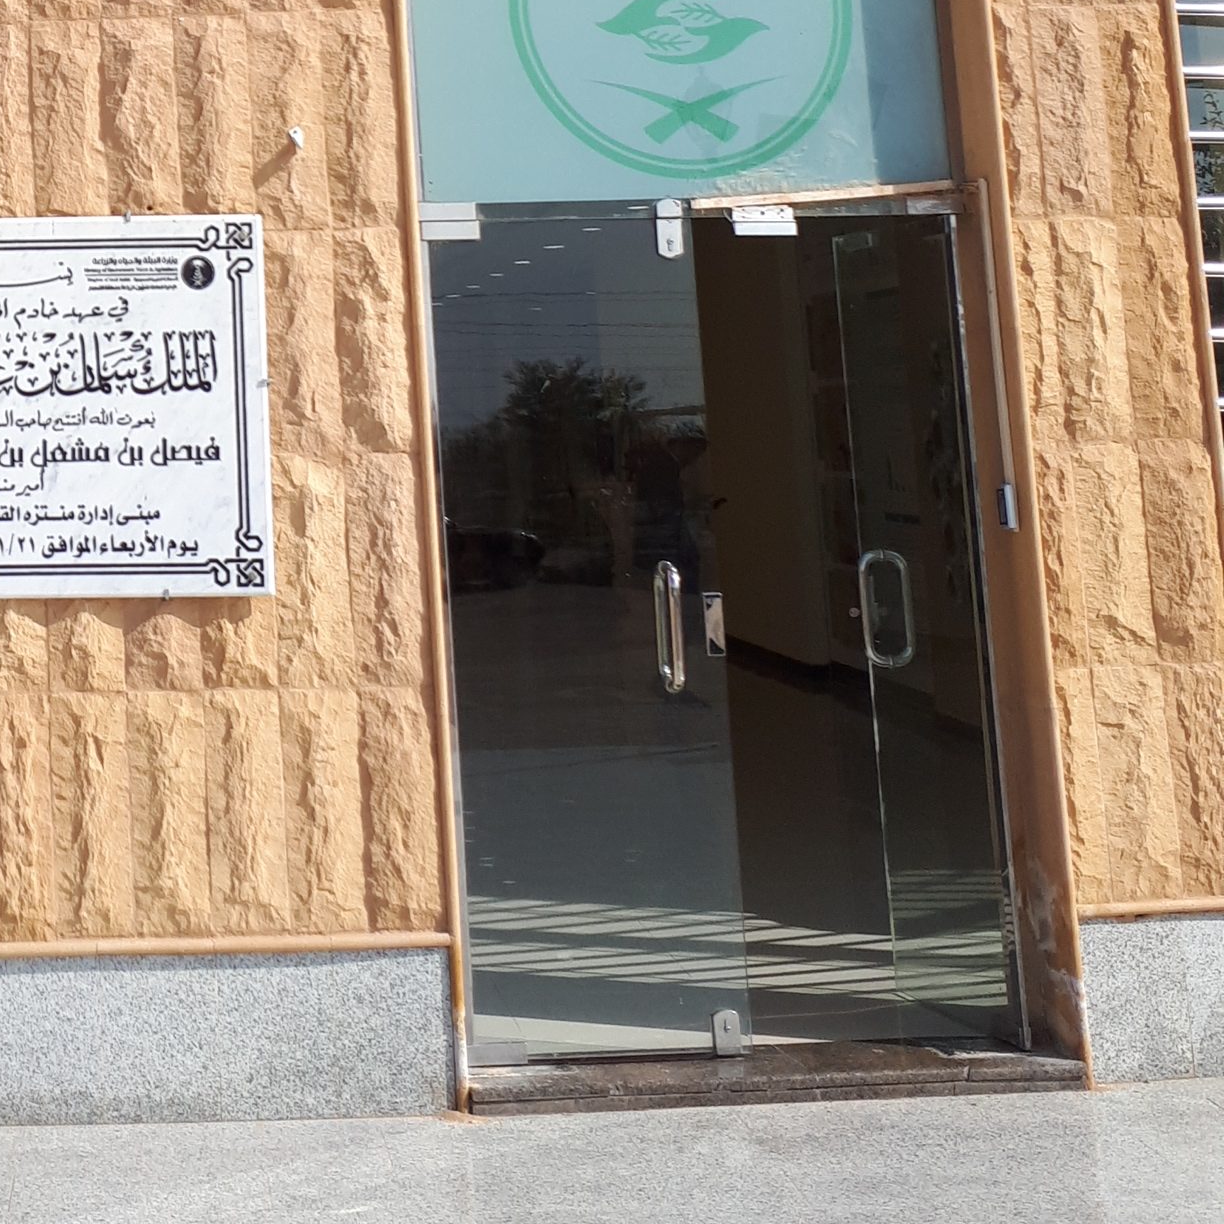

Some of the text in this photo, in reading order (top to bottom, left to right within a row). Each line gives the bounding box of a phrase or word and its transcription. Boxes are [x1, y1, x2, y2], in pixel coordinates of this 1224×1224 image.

[13, 297, 60, 329] خادم
[62, 304, 105, 324] عهد
[107, 296, 129, 323] في
[30, 438, 110, 468] مشعل
[117, 437, 143, 467] بن
[150, 436, 221, 467] فيصل
[23, 504, 75, 526] منتزه
[77, 504, 114, 526] إدارة
[116, 504, 161, 526] مبنى
[41, 534, 97, 559] الموافق
[99, 530, 165, 556] الأربعاء
[167, 537, 199, 559] يوم
